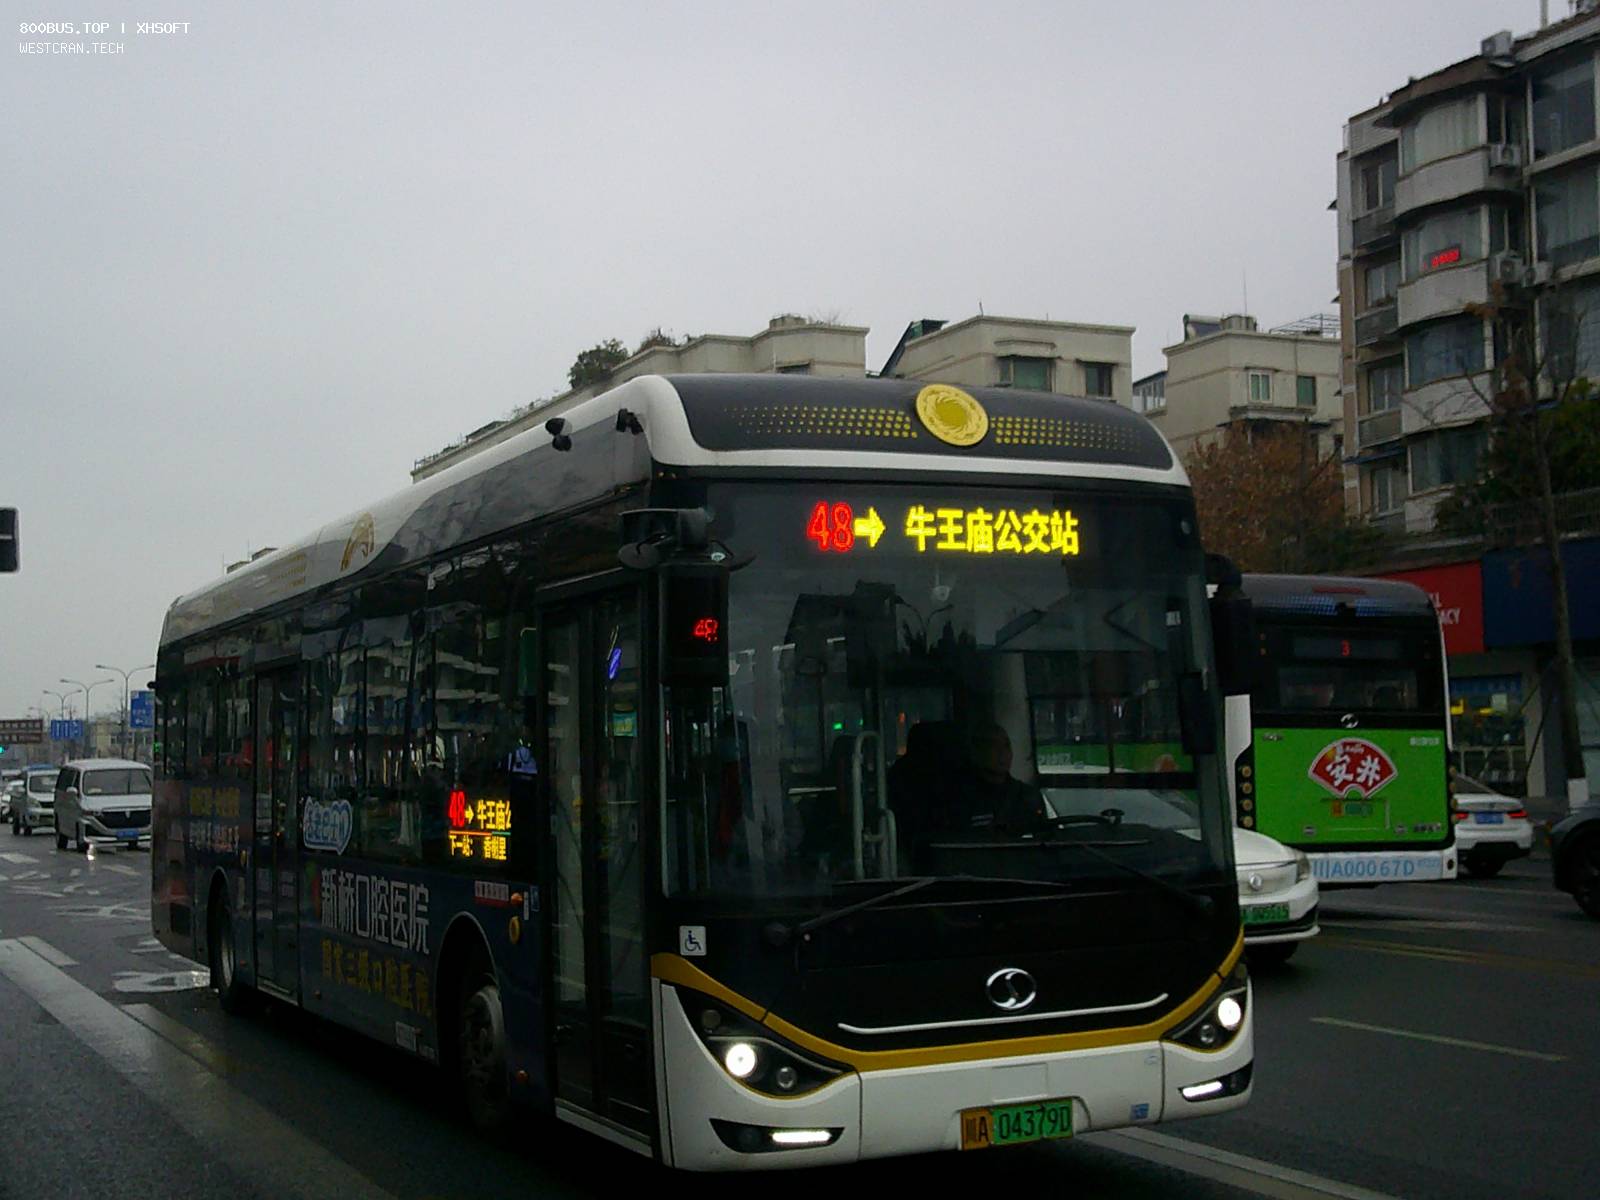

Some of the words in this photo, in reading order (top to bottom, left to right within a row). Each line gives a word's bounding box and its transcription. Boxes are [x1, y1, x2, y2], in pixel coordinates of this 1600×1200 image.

[807, 501, 853, 550] 48
[906, 504, 1080, 555] 牛王庙公交站
[1325, 743, 1381, 787] 安井
[449, 791, 466, 828] 48
[321, 868, 430, 955] 新桥口腔医院
